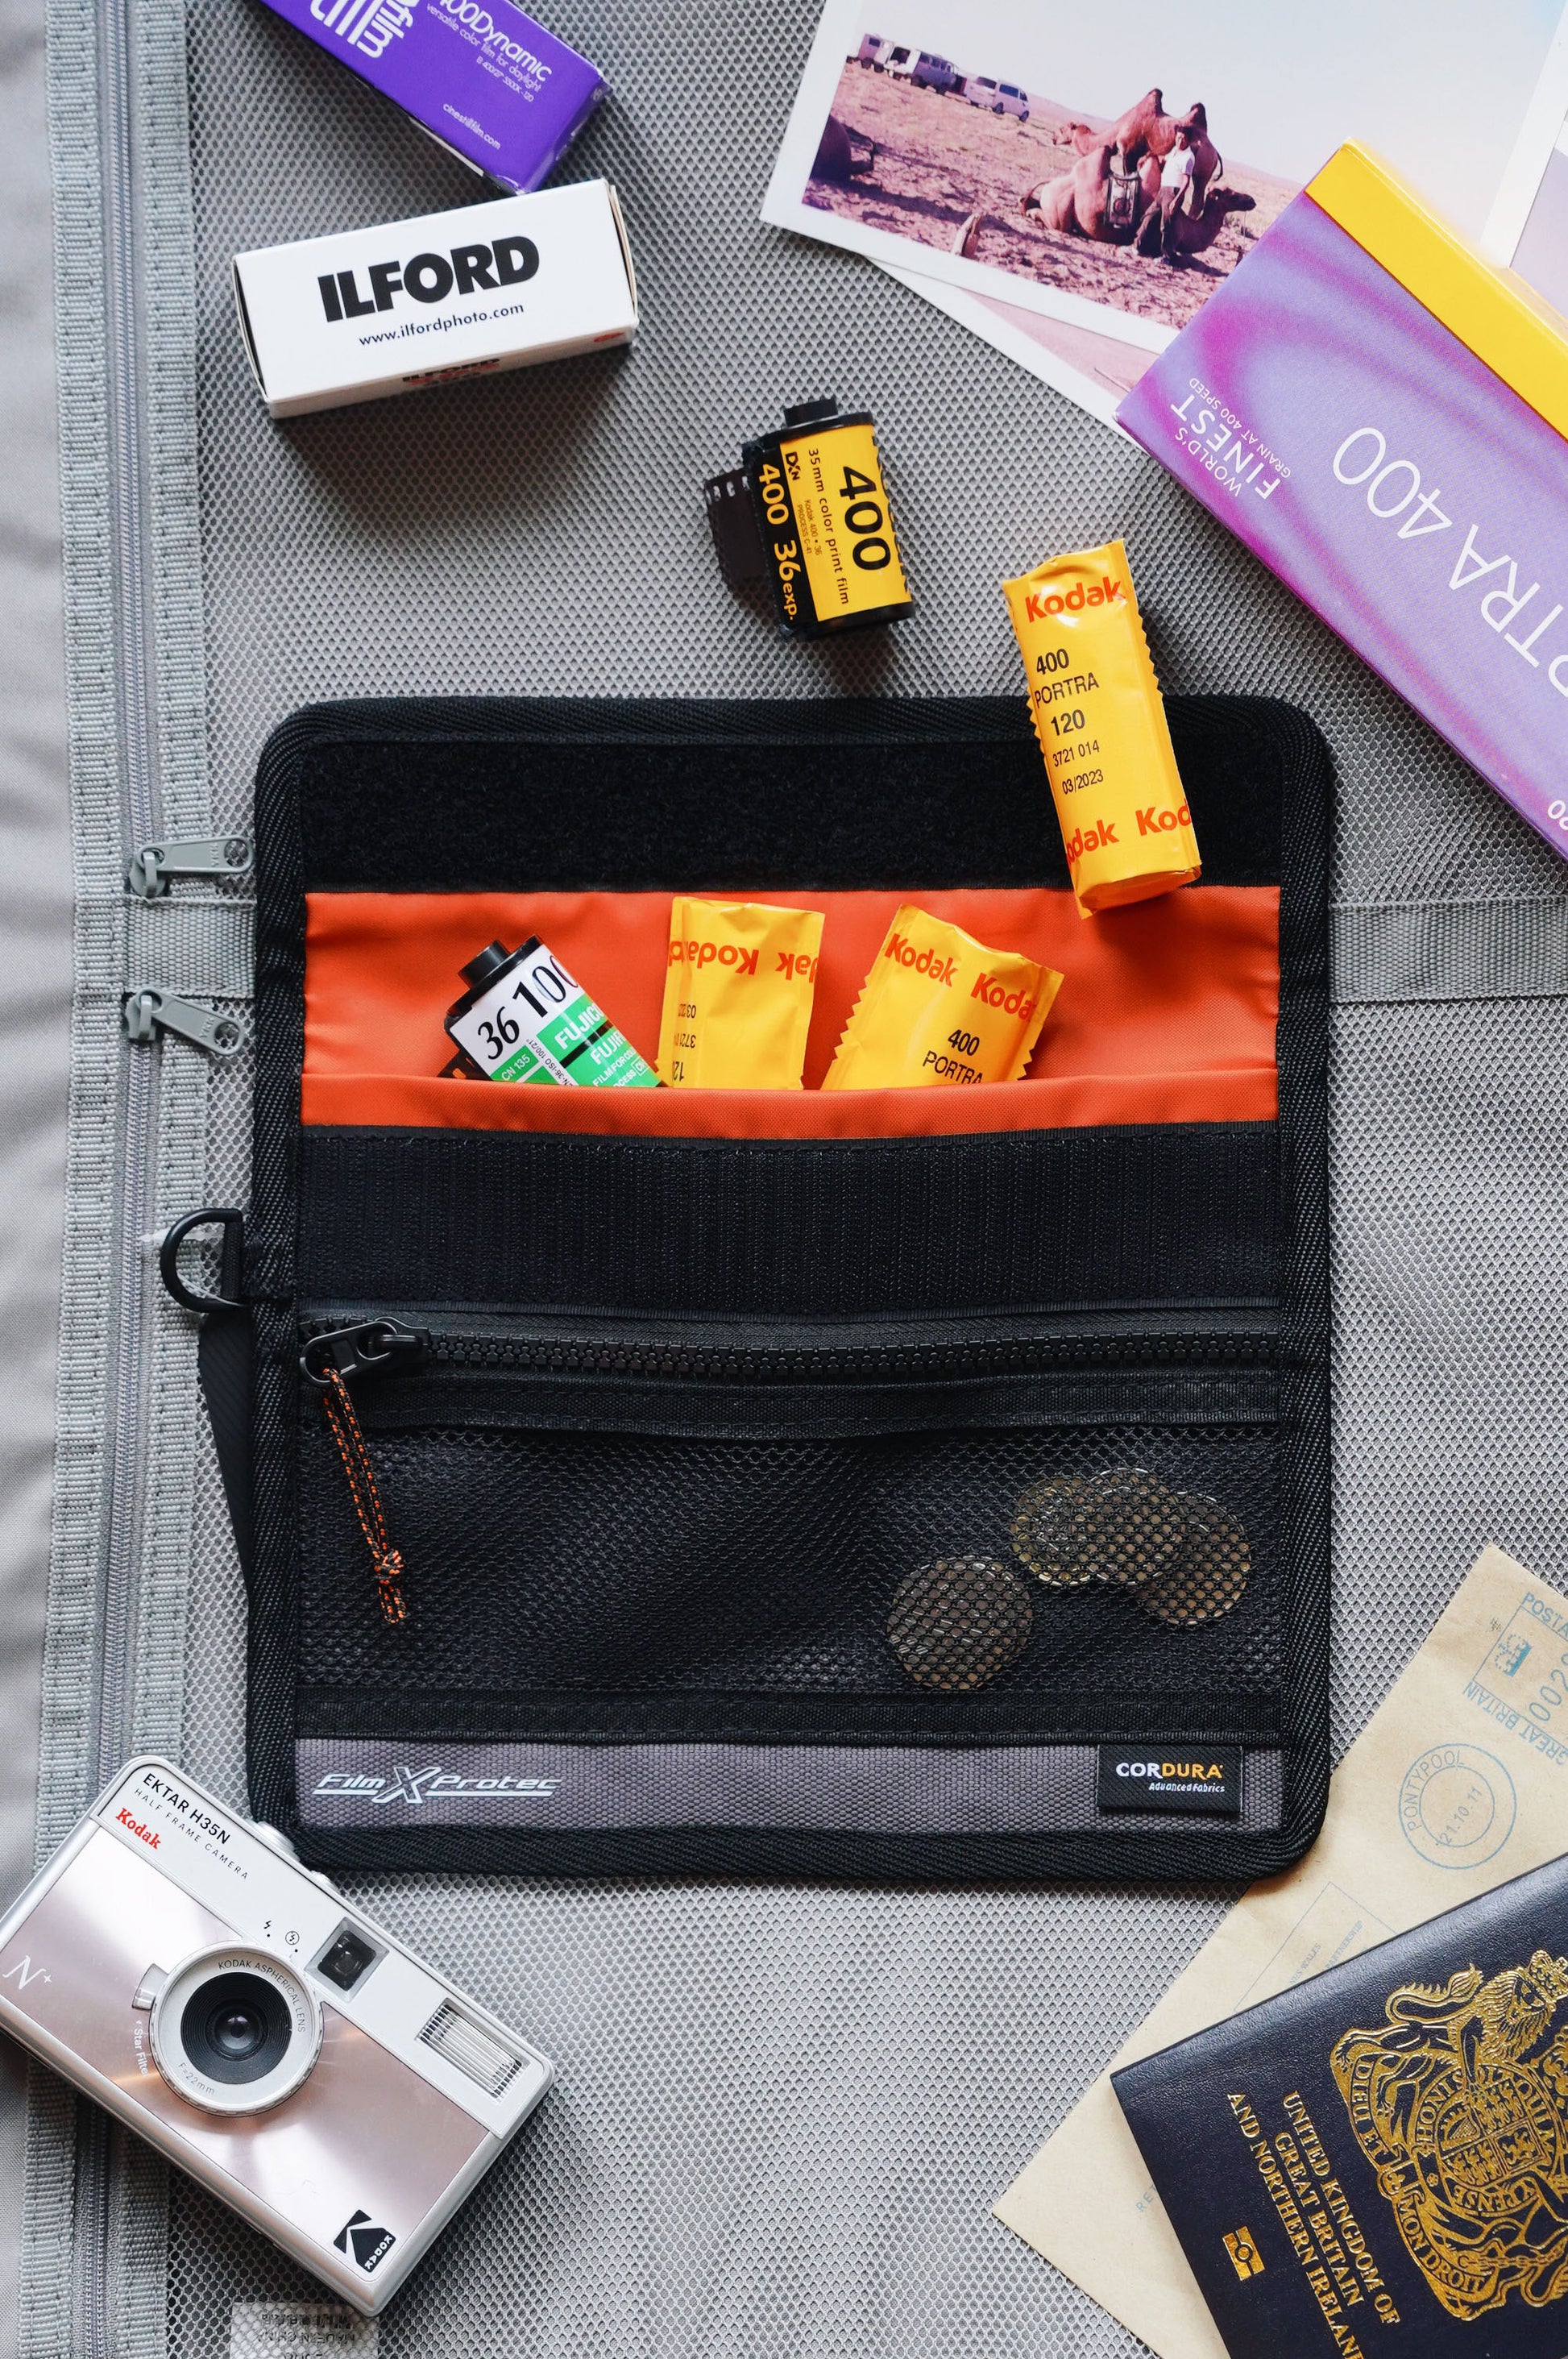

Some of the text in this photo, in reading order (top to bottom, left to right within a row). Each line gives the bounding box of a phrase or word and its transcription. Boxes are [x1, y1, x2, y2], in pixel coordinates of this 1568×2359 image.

[427, 4, 542, 93] versatile color film for daylight
[440, 0, 552, 81] 00Dynamic
[443, 103, 500, 150] cinestillfilm.com
[317, 235, 540, 322] ILFORD
[359, 304, 525, 346] www.ilfordphoto.com
[1170, 394, 1281, 500] FINEST
[1188, 377, 1291, 478] GRAIN AT 400 SPEED
[1175, 427, 1242, 496] WORLD'S
[1332, 426, 1453, 539] 400
[758, 463, 790, 525] 400
[797, 504, 809, 538] PROCESS
[840, 466, 891, 571] 400
[804, 499, 822, 555] Kodak 400 36
[808, 447, 849, 604] 35mm color print film
[1025, 576, 1126, 623] Kodak
[1034, 672, 1100, 708] PORTRA
[1035, 648, 1070, 675] 400
[1050, 708, 1085, 737] 120
[1052, 738, 1100, 767] 3721 014
[1061, 769, 1104, 795] 03/2023
[1065, 819, 1120, 866] odak
[884, 933, 958, 987] Kodak
[477, 1006, 520, 1060] 36
[948, 1029, 980, 1056] 400
[500, 1054, 531, 1081] CN 135
[673, 1061, 685, 1082] 12
[1462, 1681, 1568, 1765] GREAT BRITAIN
[143, 1773, 230, 1844] EKTAR H35N
[1148, 1782, 1226, 1792] Advanced Fabrics
[1404, 1750, 1464, 1831] PONTYPOOL
[115, 1807, 161, 1850] Kodak
[134, 1788, 249, 1879] HALF FRAME CAMERA
[218, 1959, 306, 2033] KODAK ASPHERICAL LENS
[134, 2029, 143, 2050] Star
[1351, 2060, 1389, 2166] DIEU ET
[1227, 2092, 1260, 2138] AND
[1250, 2138, 1319, 2266] NORTHERN
[1282, 2090, 1400, 2324] UNITED KINGDOM OF
[1274, 2131, 1365, 2307] GREAT BRITAIN
[1396, 2195, 1487, 2294] MON DROIT
[364, 2235, 392, 2270] KODAK
